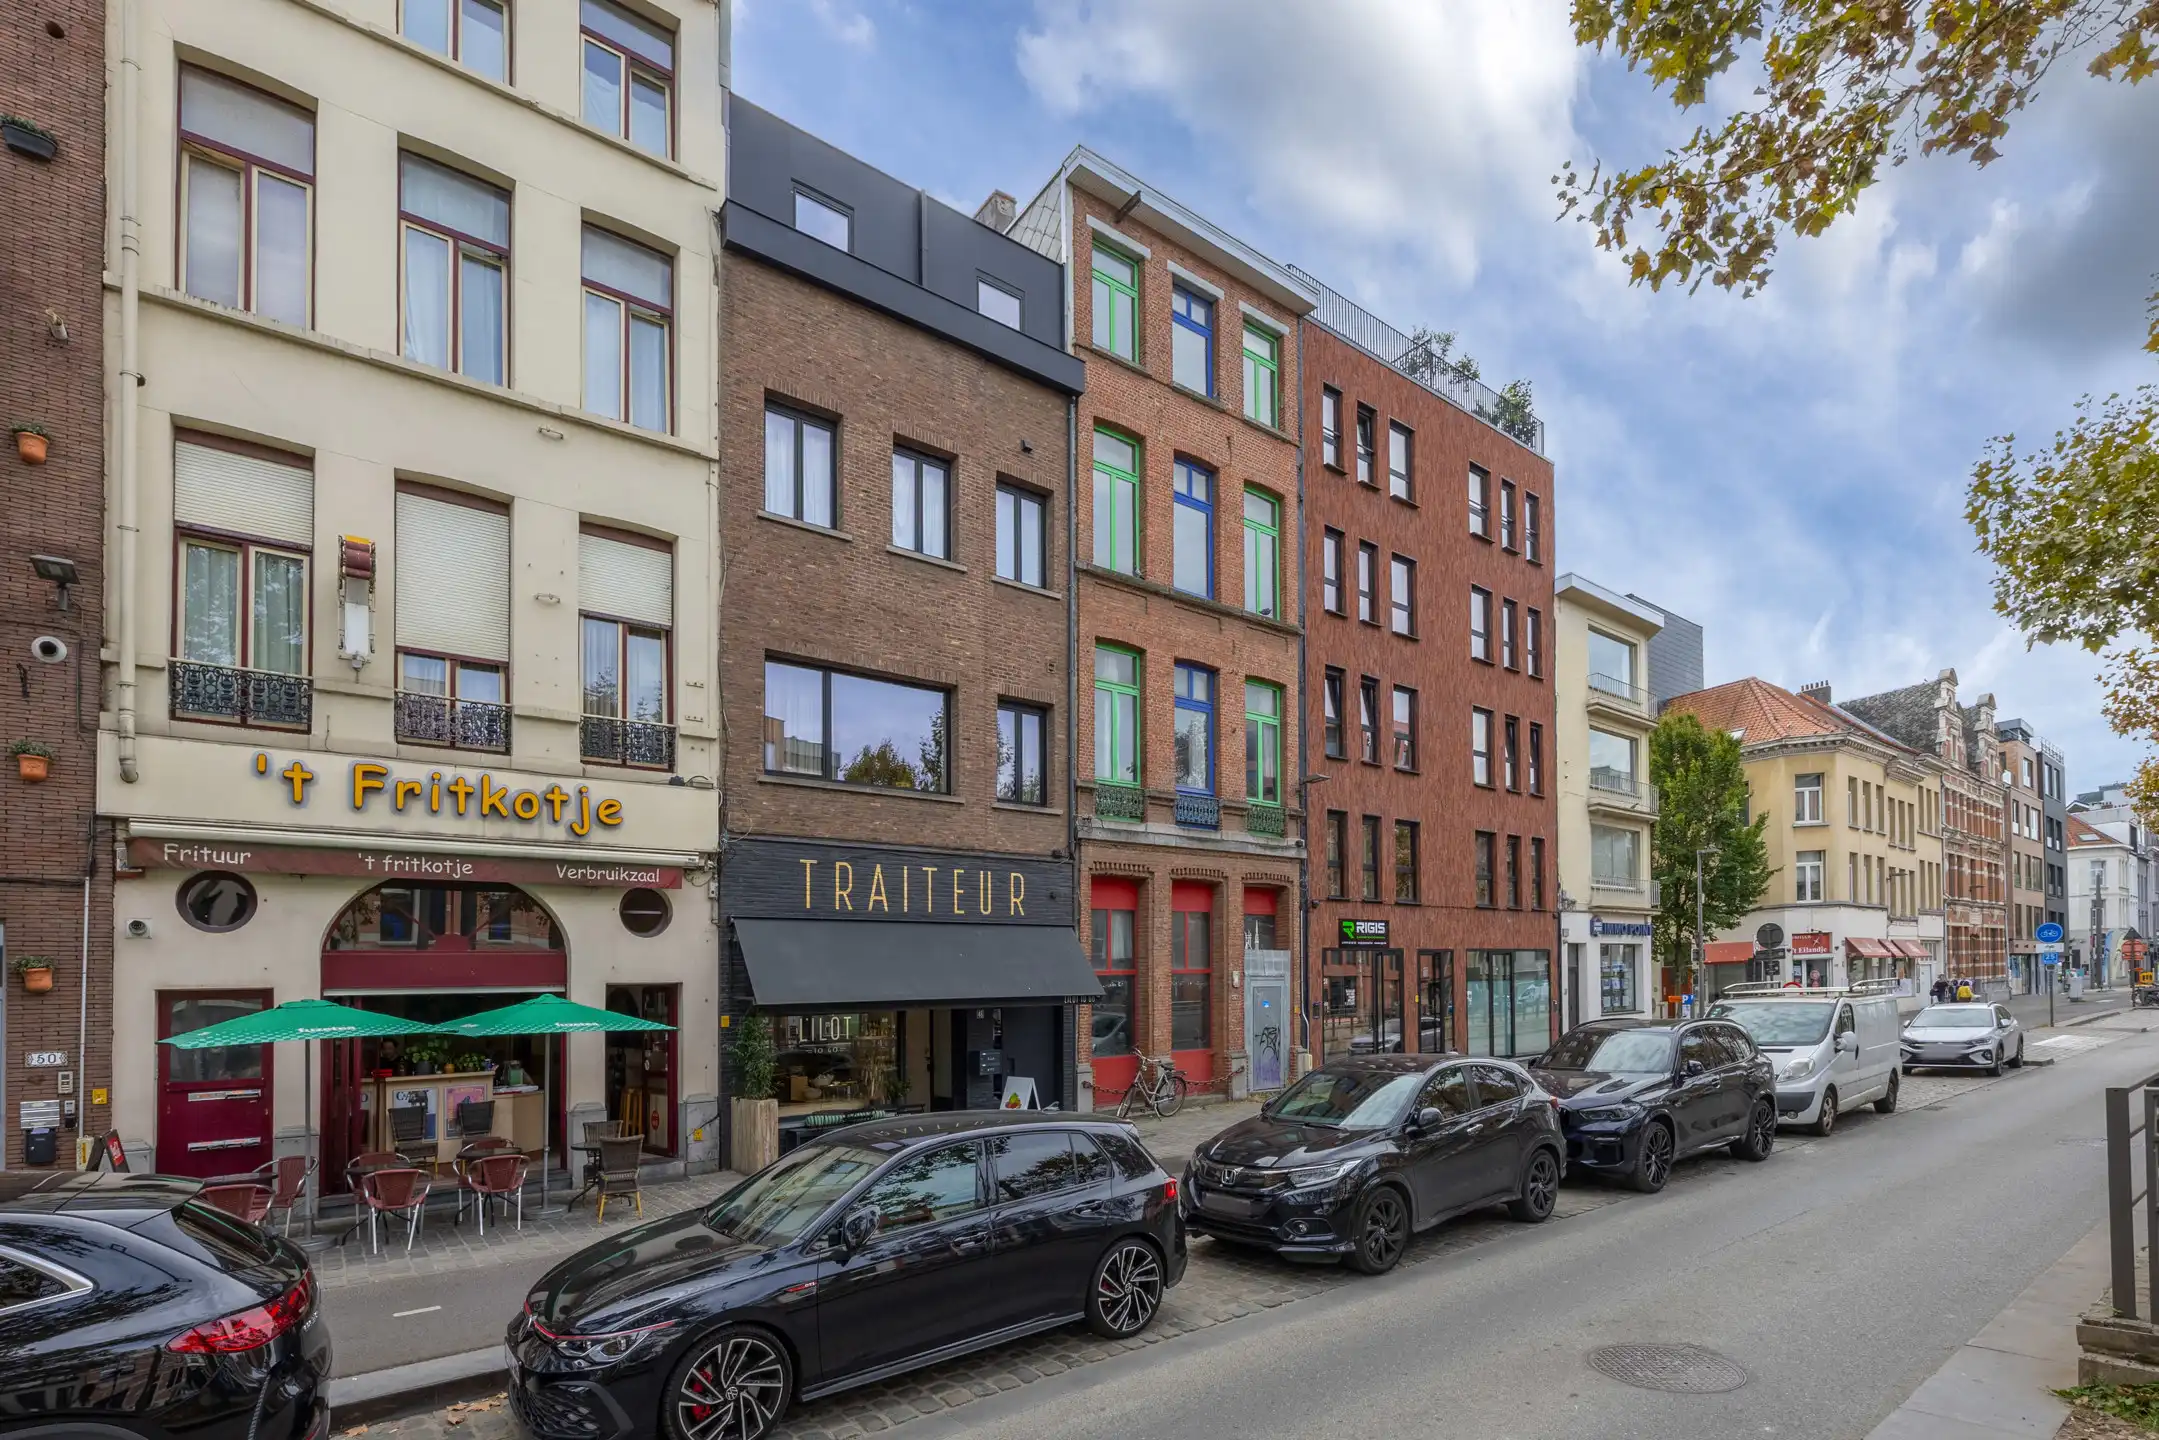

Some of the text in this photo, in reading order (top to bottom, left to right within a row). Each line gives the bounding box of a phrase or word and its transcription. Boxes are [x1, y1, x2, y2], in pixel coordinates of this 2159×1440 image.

[256, 753, 624, 837] 't Fritkotje
[163, 842, 252, 865] Frituur
[357, 852, 473, 879] 't fritkotje
[556, 863, 660, 883] Verbruikzaal
[799, 858, 1026, 917] TRAITEUR
[1356, 921, 1386, 934] RIGIS
[1604, 923, 1627, 936] IMMO
[37, 1054, 57, 1064] 50
